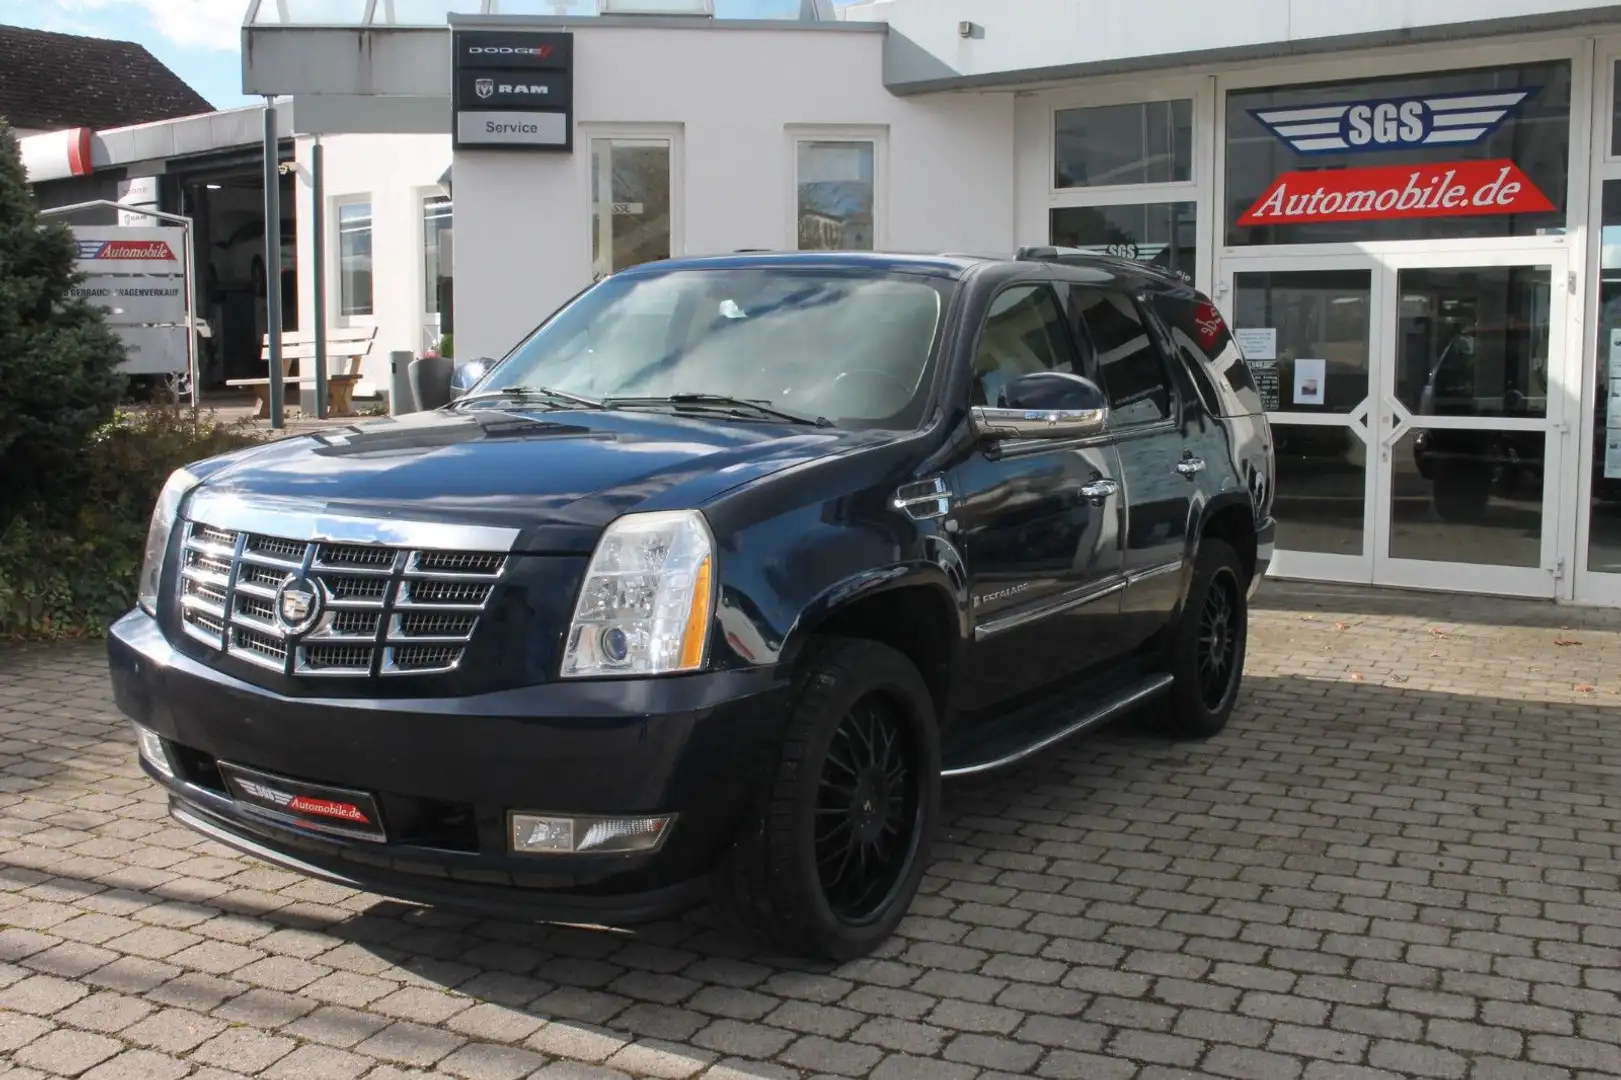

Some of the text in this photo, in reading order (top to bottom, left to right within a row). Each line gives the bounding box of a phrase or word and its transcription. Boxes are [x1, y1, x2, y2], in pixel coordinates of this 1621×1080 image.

[469, 46, 542, 55] DODGE
[498, 84, 549, 94] RAM
[485, 121, 538, 133] Service
[1348, 100, 1424, 146] SGS
[1251, 165, 1522, 218] Automobile.de
[100, 243, 168, 258] Automobile
[291, 798, 362, 819] Automobile.de
